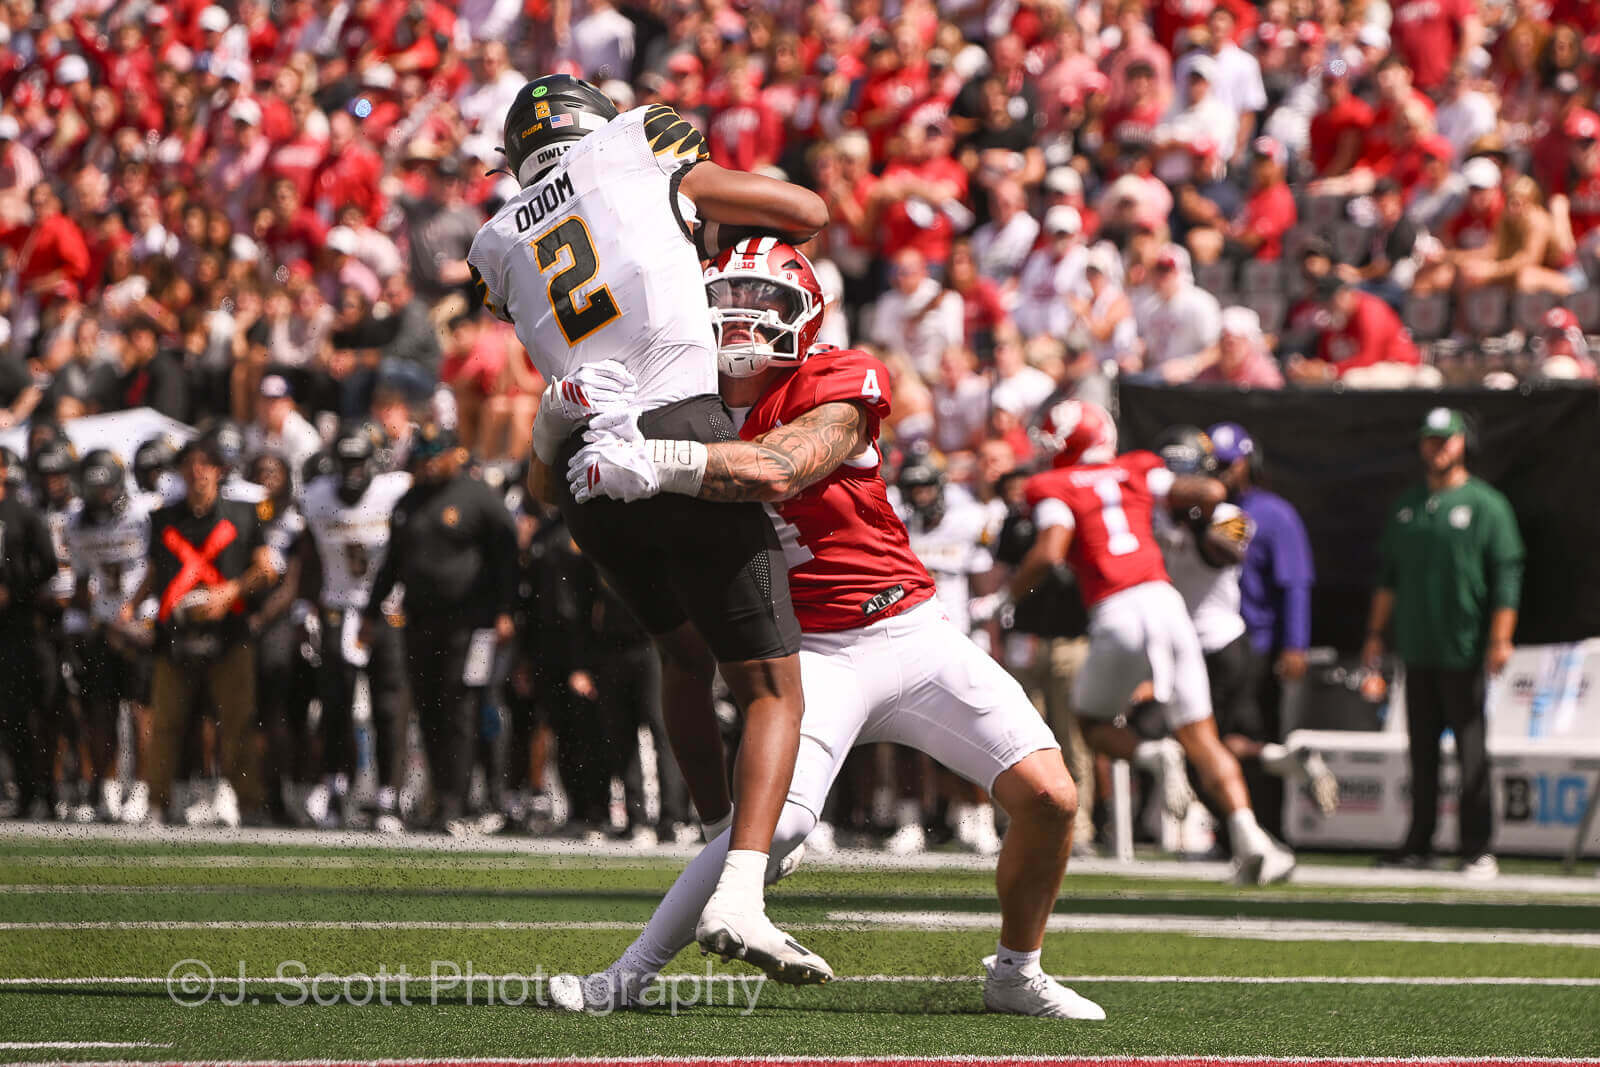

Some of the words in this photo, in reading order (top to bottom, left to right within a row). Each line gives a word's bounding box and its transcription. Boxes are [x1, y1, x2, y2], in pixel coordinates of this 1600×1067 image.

[515, 171, 575, 233] ODOM
[529, 215, 622, 348] 2
[861, 368, 882, 402] 4
[1092, 476, 1140, 556] 1
